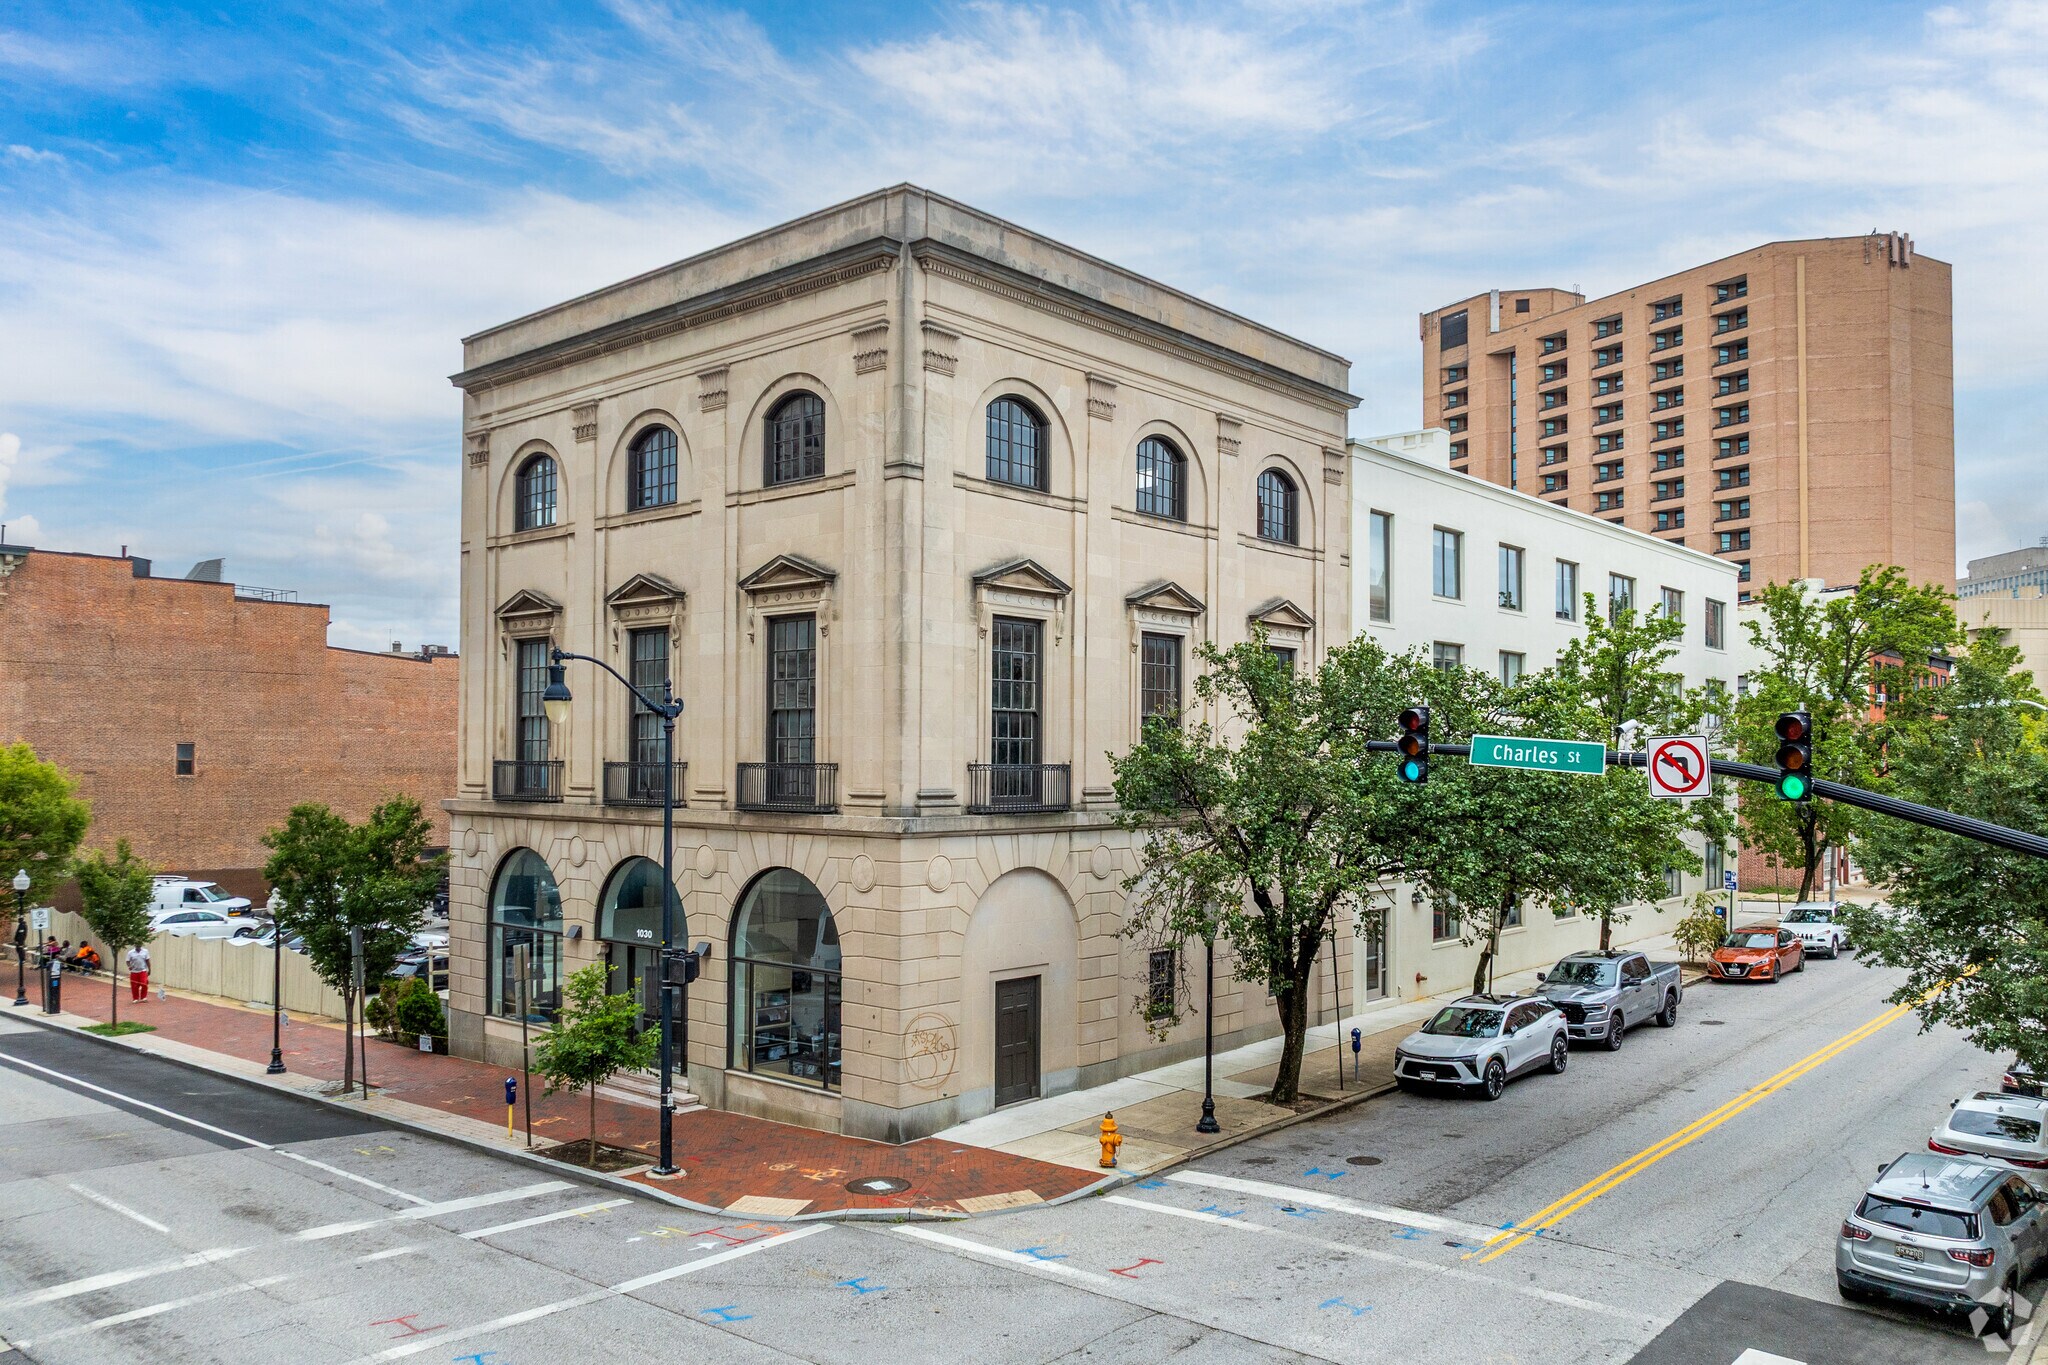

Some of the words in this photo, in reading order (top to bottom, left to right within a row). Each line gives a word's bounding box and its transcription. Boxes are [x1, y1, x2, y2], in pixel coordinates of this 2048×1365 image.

[1493, 744, 1558, 764] Charles
[1567, 751, 1581, 763] St
[636, 929, 653, 938] 1030
